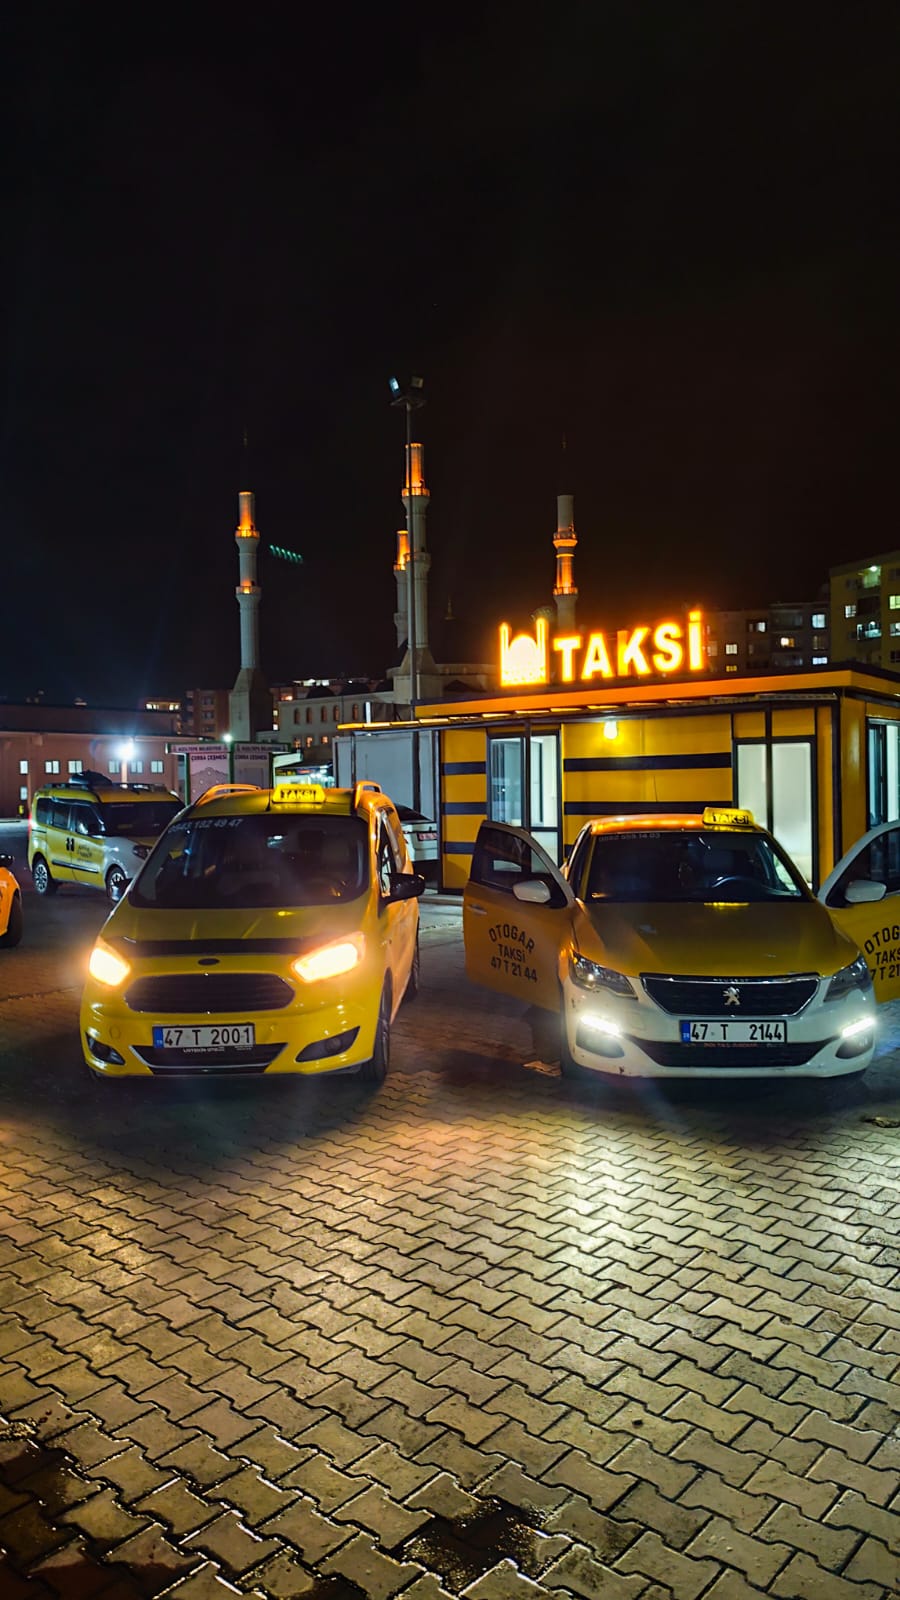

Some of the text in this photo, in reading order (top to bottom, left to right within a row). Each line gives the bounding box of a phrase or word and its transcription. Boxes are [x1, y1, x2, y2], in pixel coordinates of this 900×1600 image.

[553, 611, 703, 682] TAKSİ
[489, 923, 535, 953] OTOGAR
[497, 943, 526, 963] TAKSİ
[490, 956, 502, 969] 47
[503, 959, 509, 976] T
[879, 966, 886, 981] T
[164, 1027, 250, 1046] 47 T 2001
[691, 1023, 782, 1041] 47 T 2144
